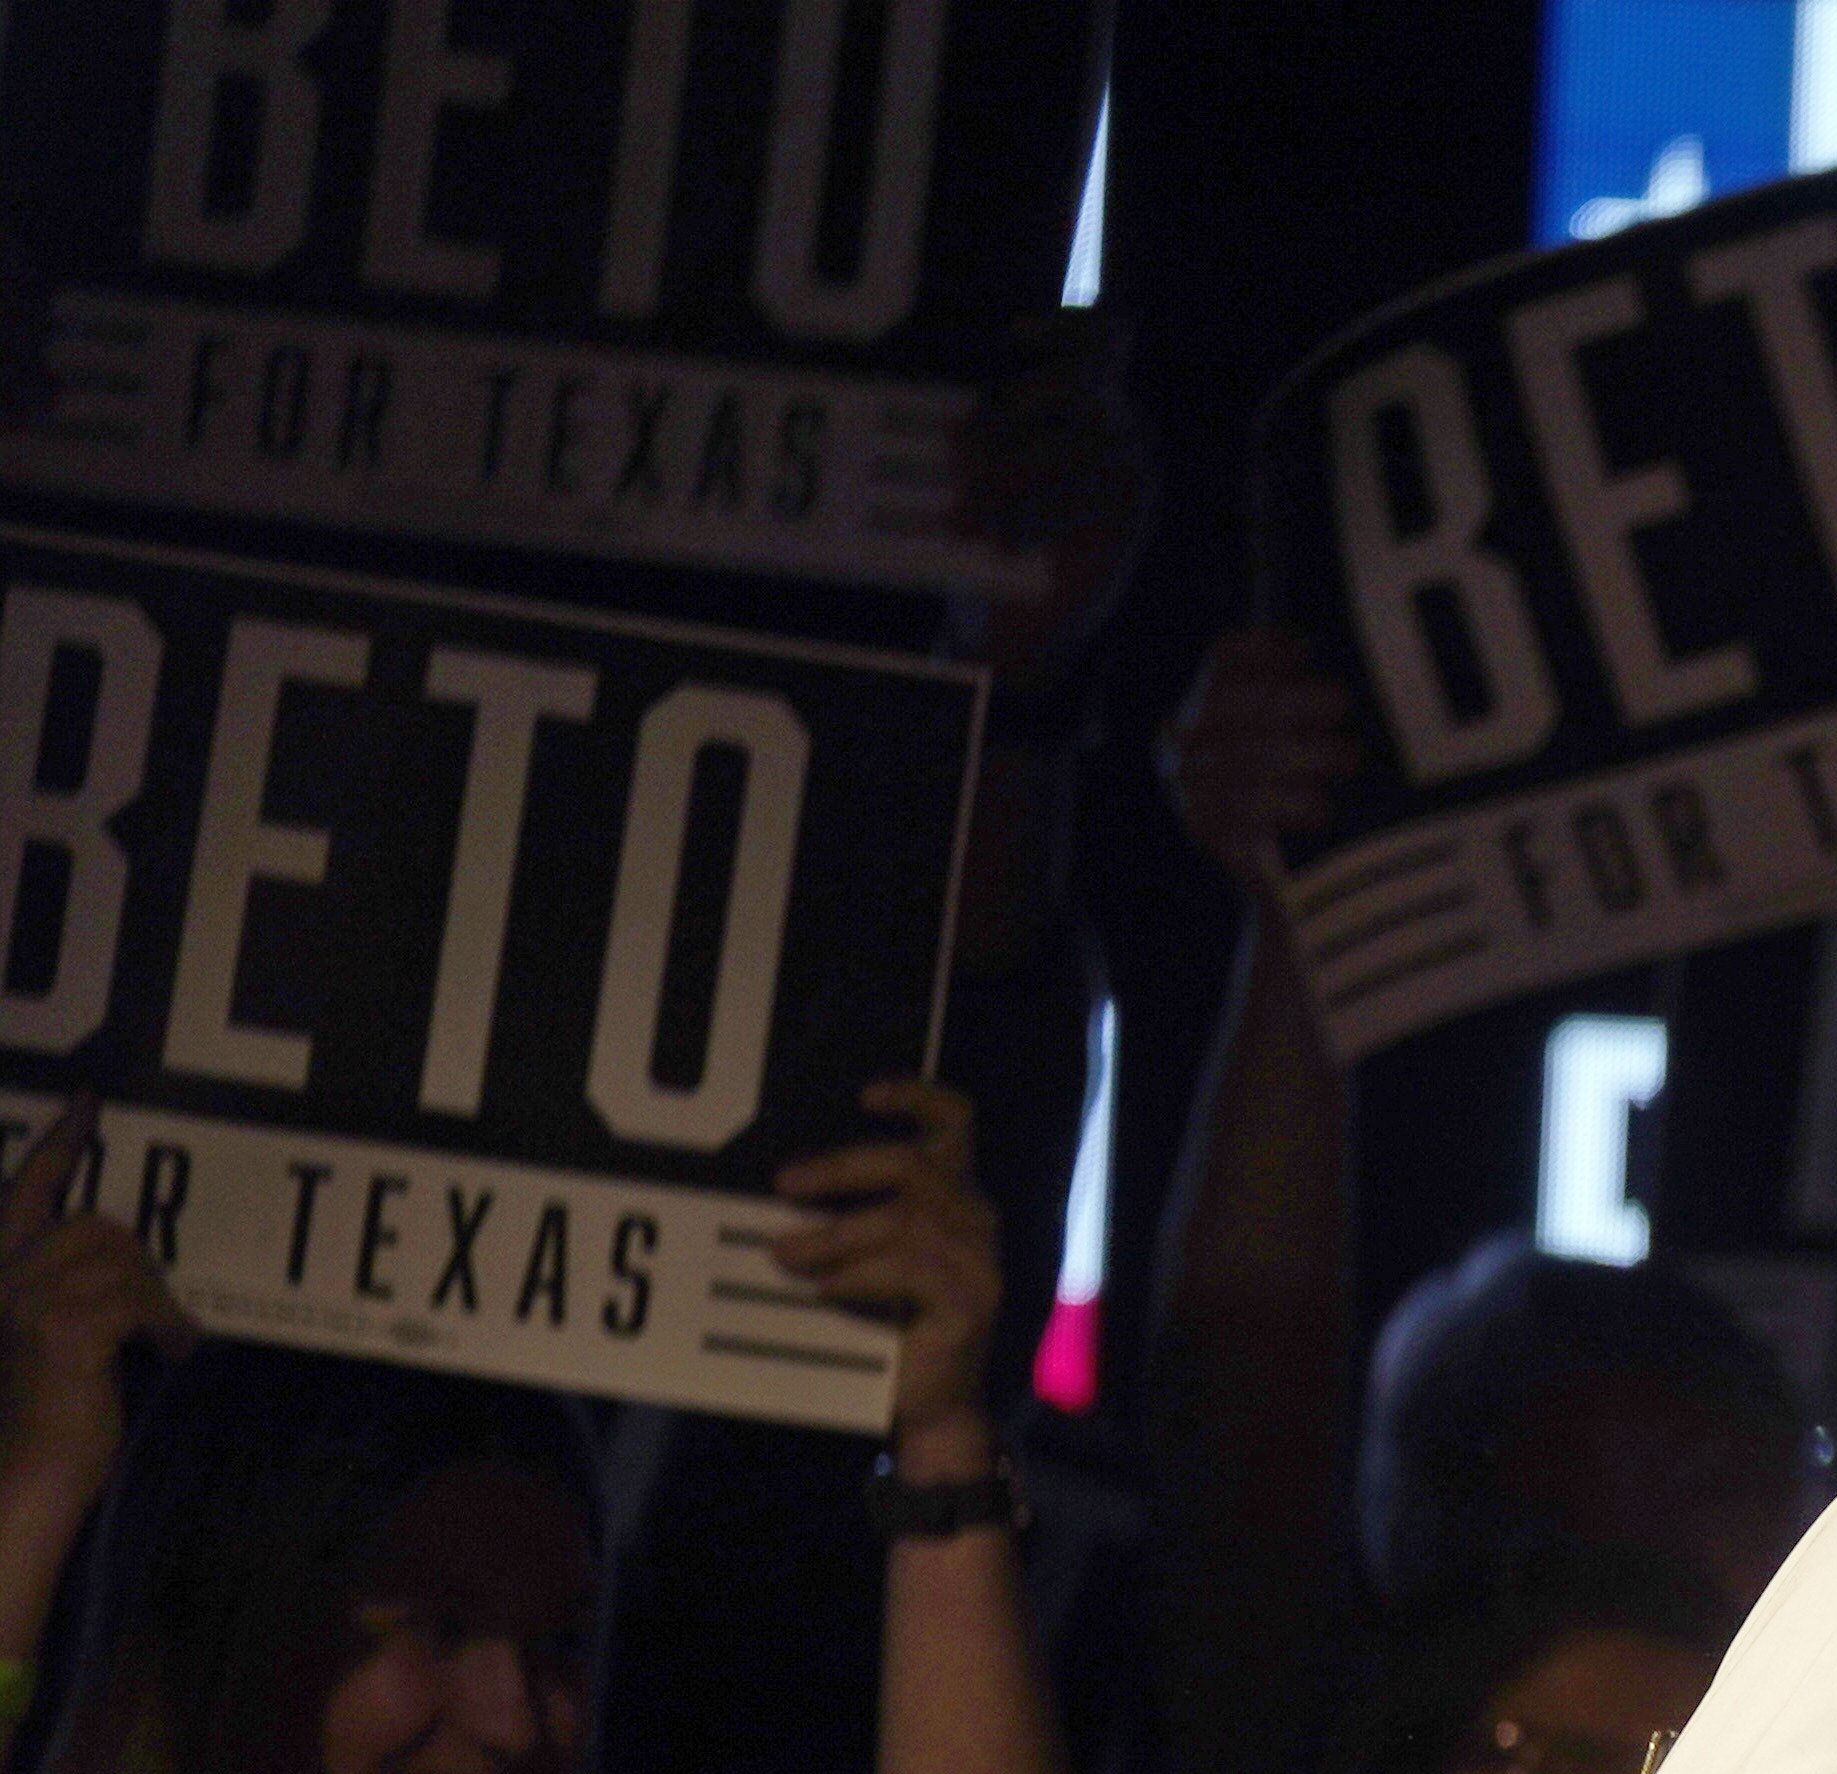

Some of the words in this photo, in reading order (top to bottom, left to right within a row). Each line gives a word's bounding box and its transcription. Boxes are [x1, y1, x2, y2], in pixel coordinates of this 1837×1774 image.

[185, 330, 396, 474] FOR
[476, 362, 835, 524] TEXAS
[0, 582, 814, 1154] BETO
[1497, 786, 1728, 934] FOR
[287, 1157, 660, 1337] TEXAS
